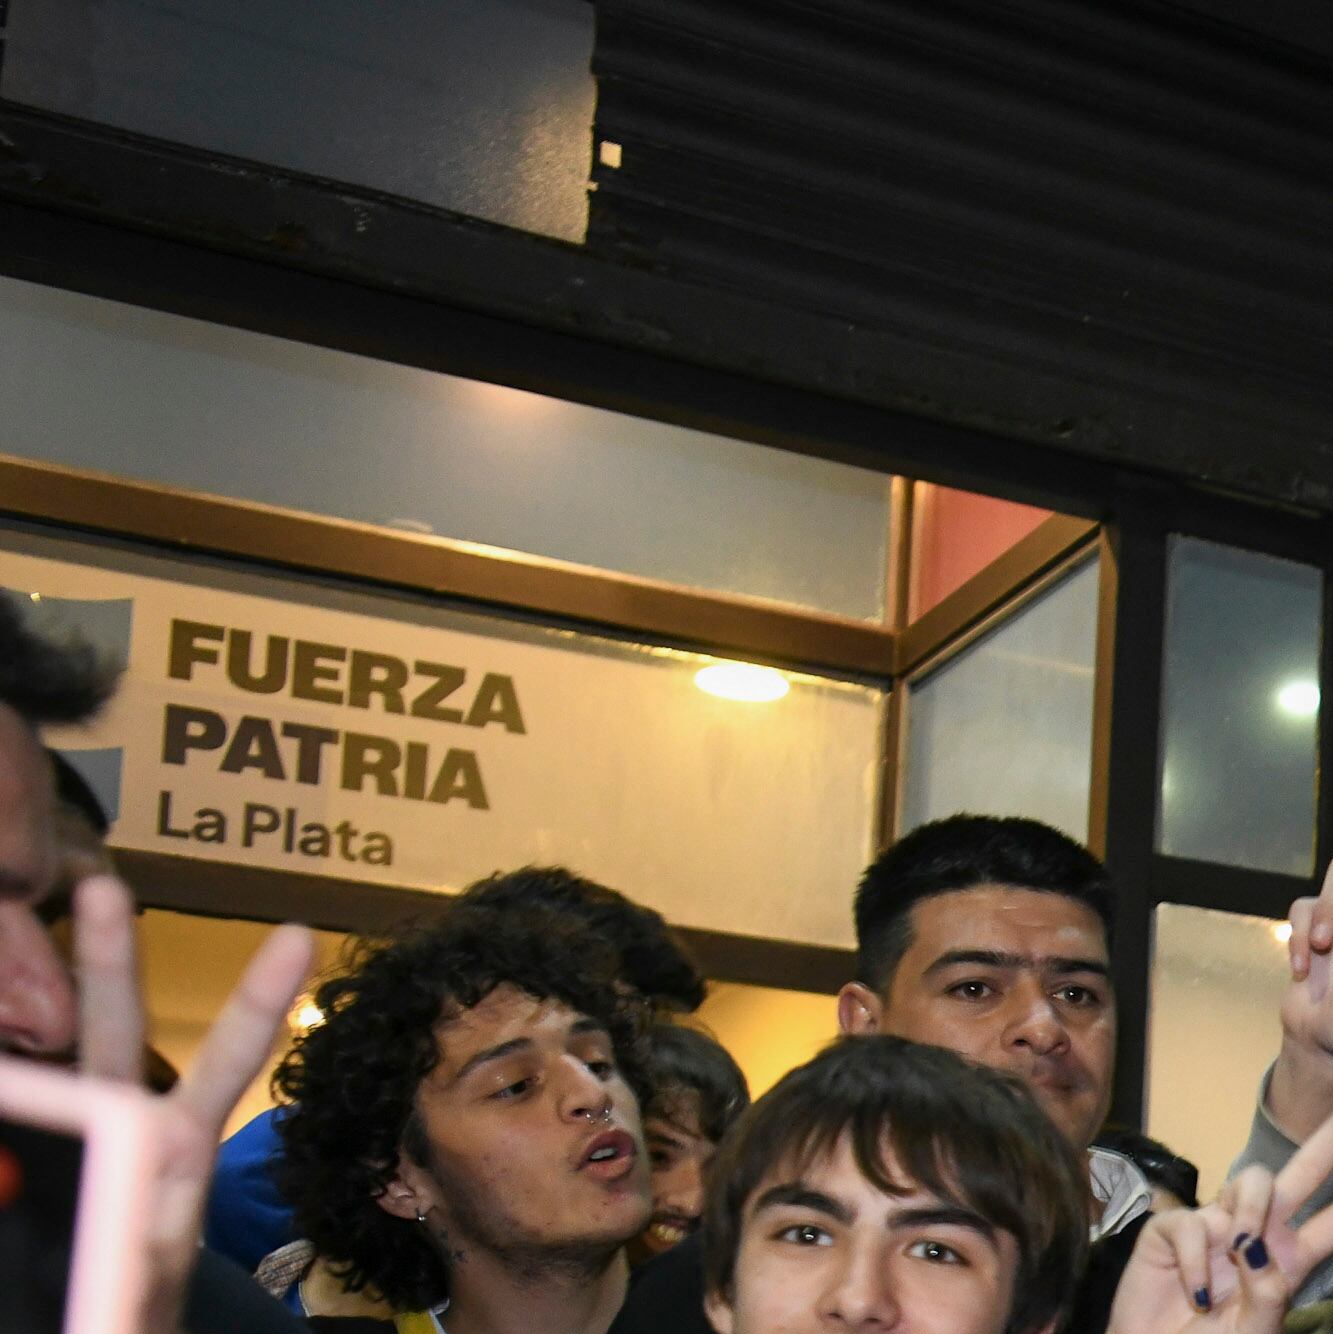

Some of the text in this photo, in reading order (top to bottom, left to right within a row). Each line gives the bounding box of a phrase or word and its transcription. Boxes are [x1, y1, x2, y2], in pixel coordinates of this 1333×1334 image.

[167, 617, 528, 735] FUERZA
[161, 703, 490, 810] PATRIA
[157, 790, 394, 866] La Plata
